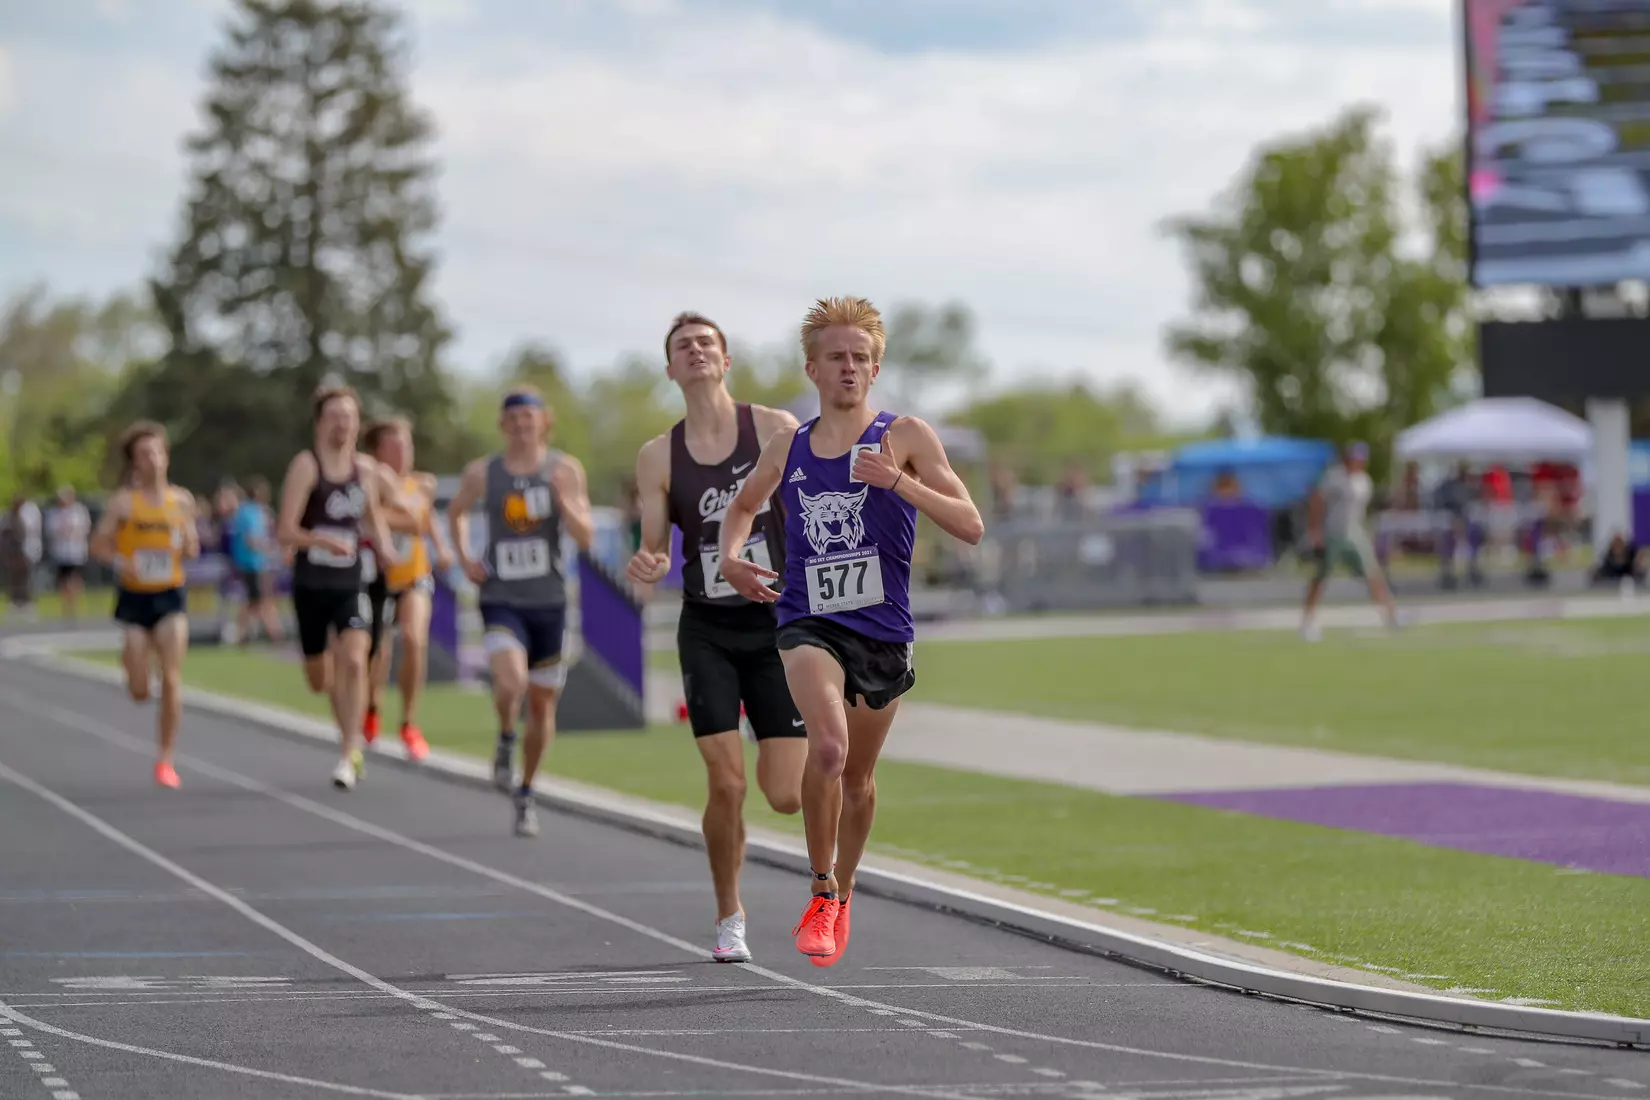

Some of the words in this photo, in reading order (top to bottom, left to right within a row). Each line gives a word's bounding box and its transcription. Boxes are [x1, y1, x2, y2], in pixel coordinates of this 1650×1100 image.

[789, 476, 807, 484] adidas
[826, 552, 861, 561] CHAMPIONSHIPS
[817, 561, 868, 600] 577
